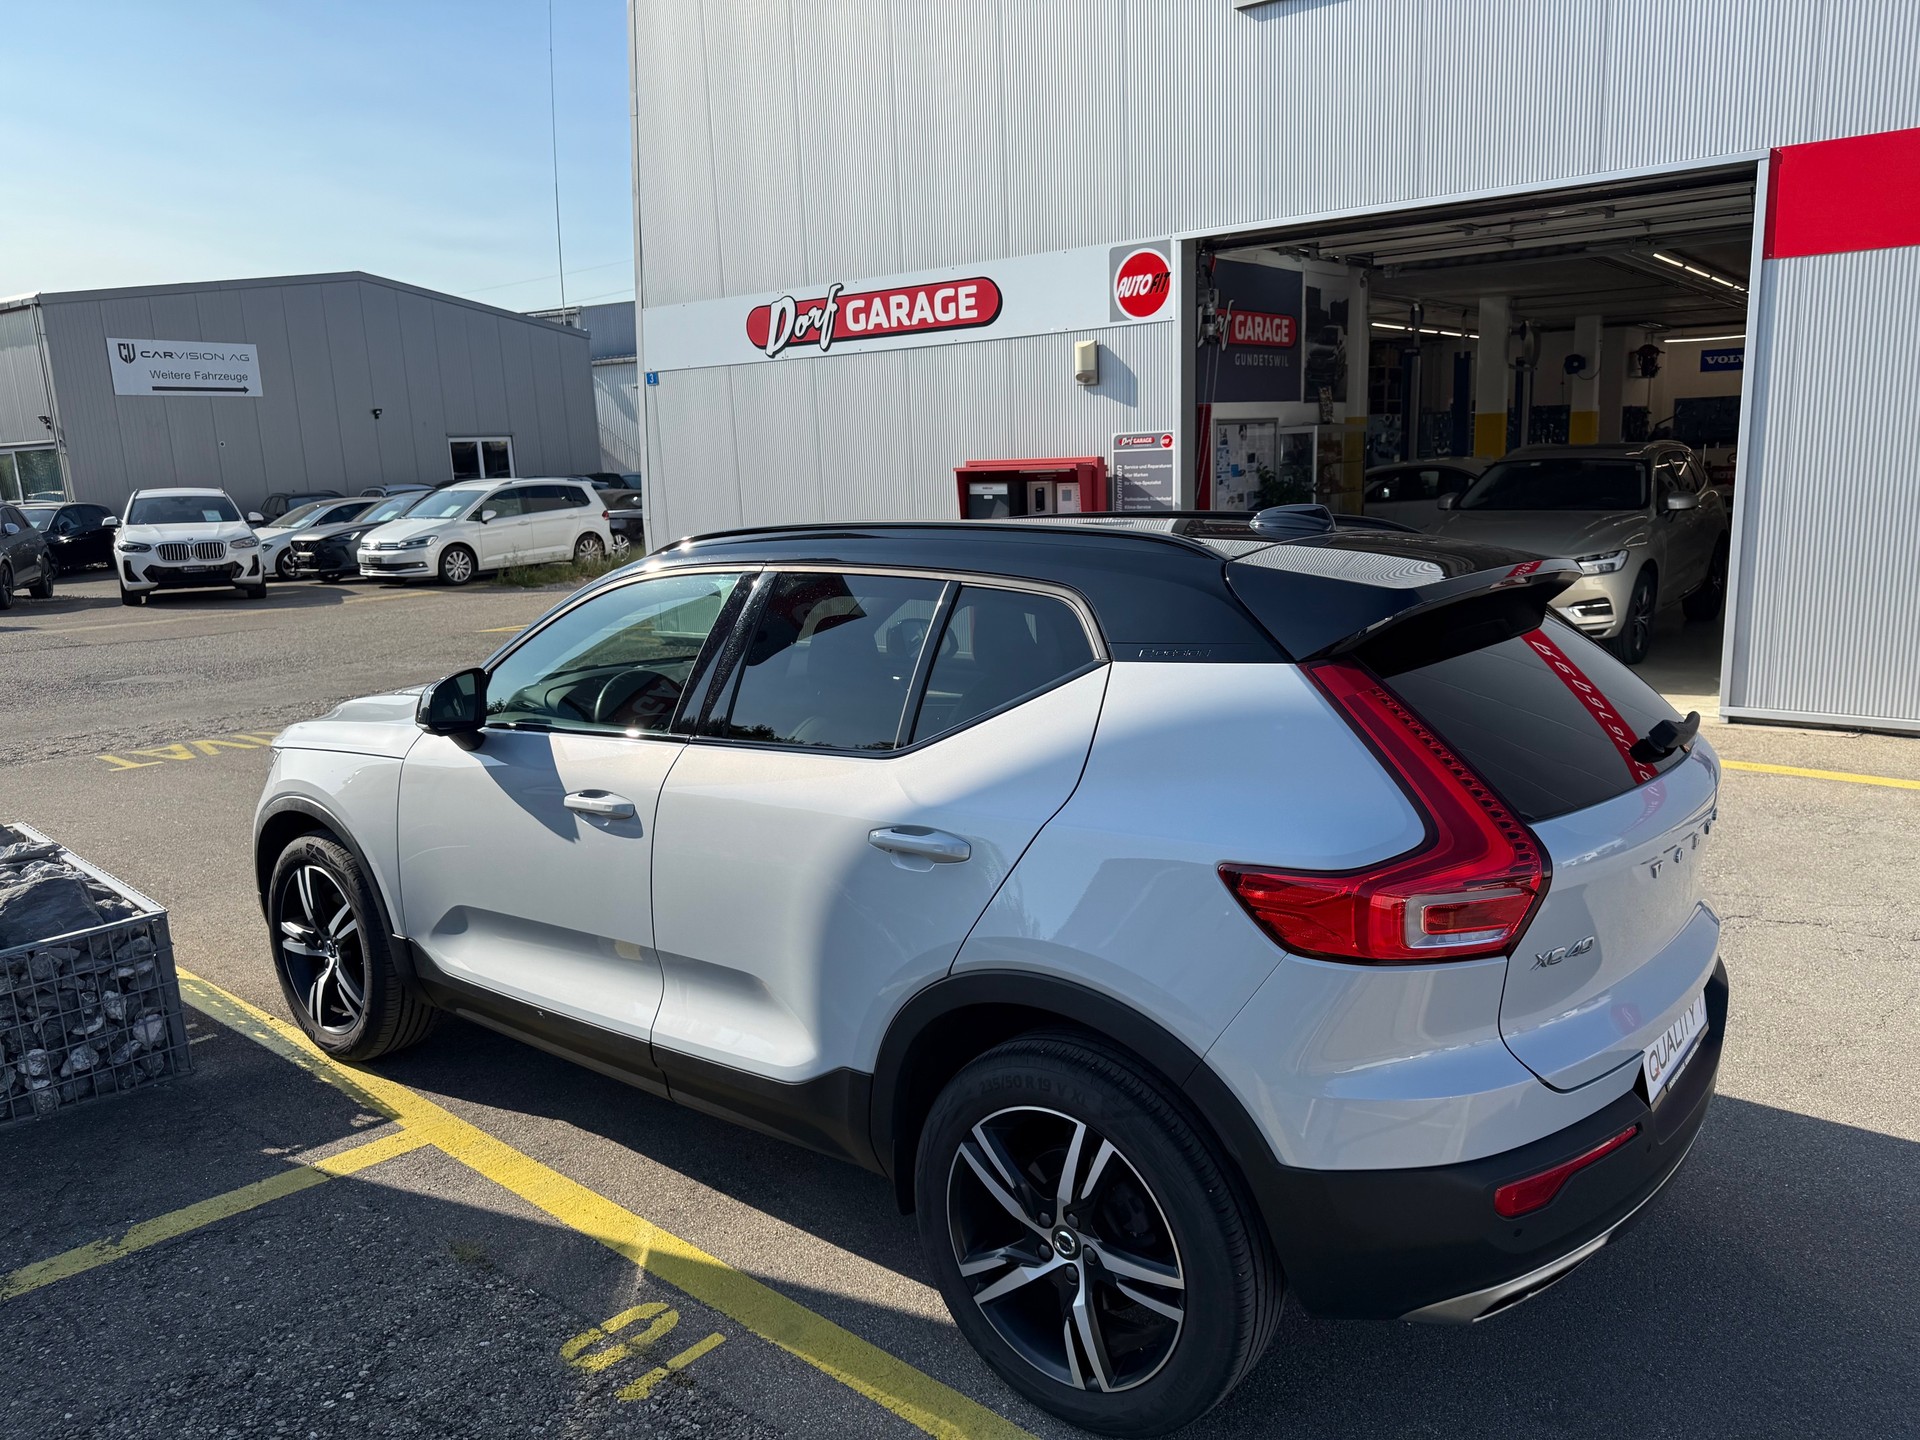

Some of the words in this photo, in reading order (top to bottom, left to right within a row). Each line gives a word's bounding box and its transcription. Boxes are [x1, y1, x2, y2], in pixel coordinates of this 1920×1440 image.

[1117, 271, 1171, 299] AUTOFIT
[765, 282, 844, 358] Dorf
[845, 285, 979, 332] GARAGE
[1234, 314, 1290, 343] GARAGE
[140, 350, 225, 361] CARVISION
[229, 353, 250, 362] AG
[1234, 352, 1289, 367] GUNDETSWIL
[1703, 354, 1745, 365] VOLV
[149, 369, 191, 380] Weitere
[194, 371, 249, 382] Fahrzeuge
[649, 373, 655, 384] 3
